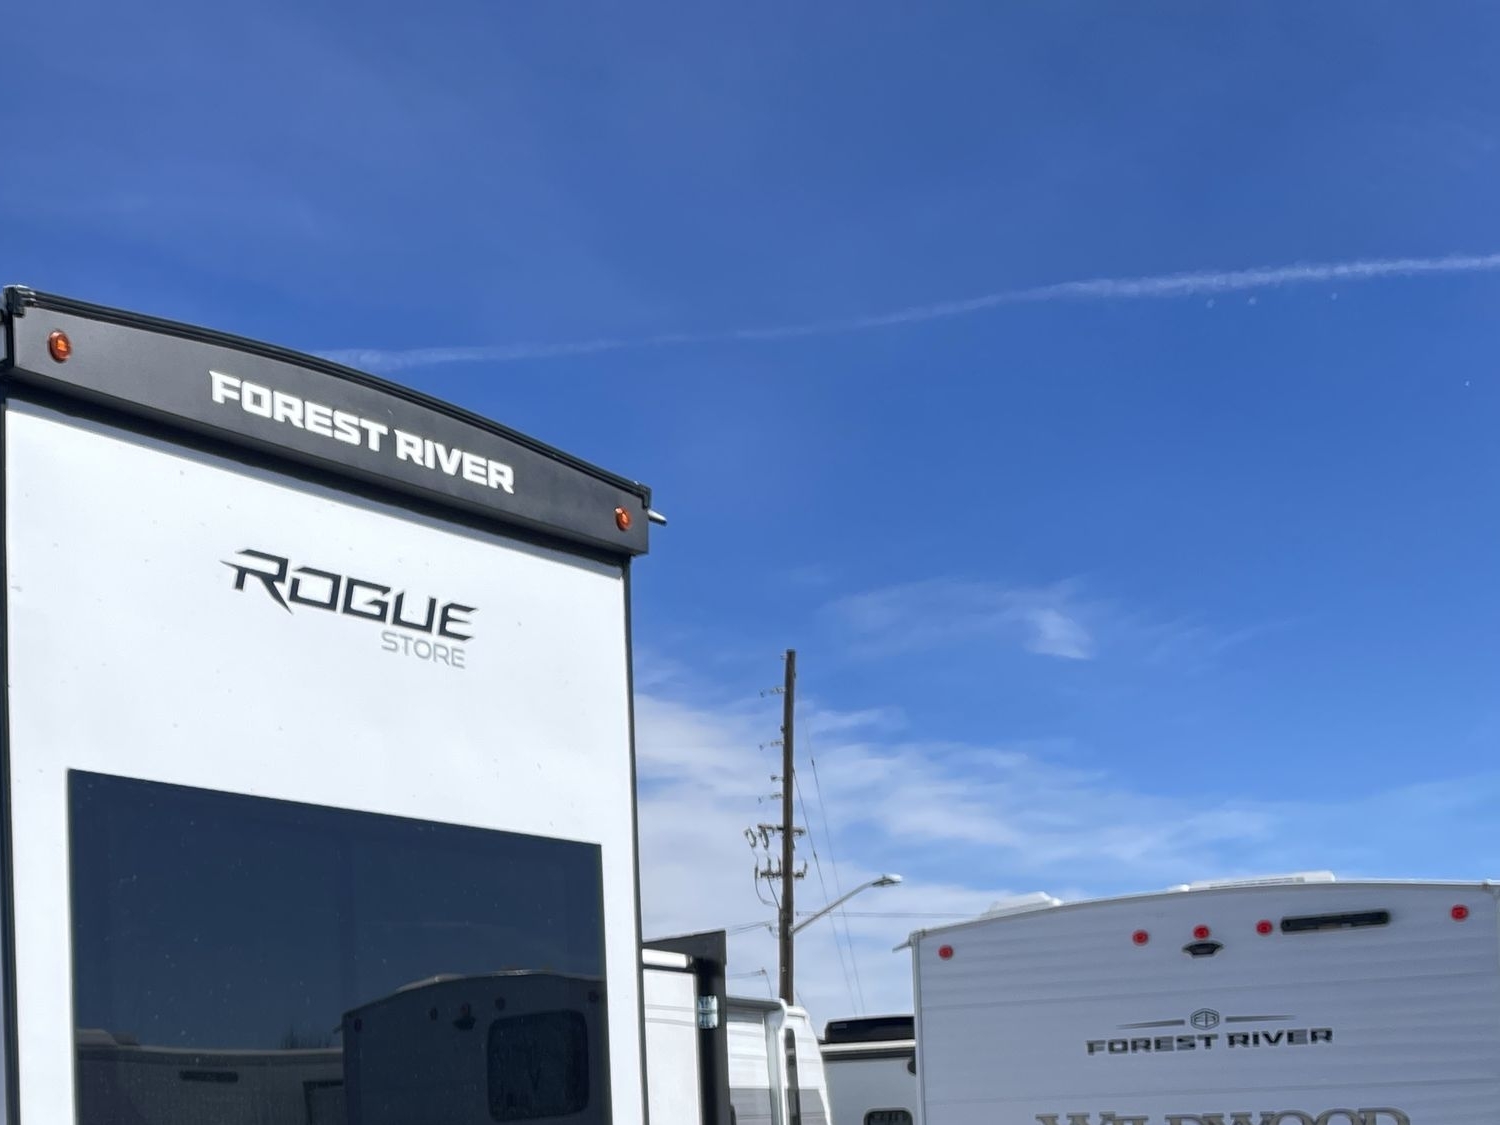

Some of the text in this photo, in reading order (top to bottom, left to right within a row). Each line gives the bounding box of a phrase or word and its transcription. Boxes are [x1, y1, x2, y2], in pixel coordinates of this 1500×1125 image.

[209, 370, 515, 494] FOREST RIVER
[219, 547, 480, 642] ROGUE
[380, 631, 466, 670] STORE
[1086, 1027, 1333, 1056] FOREST RIVER
